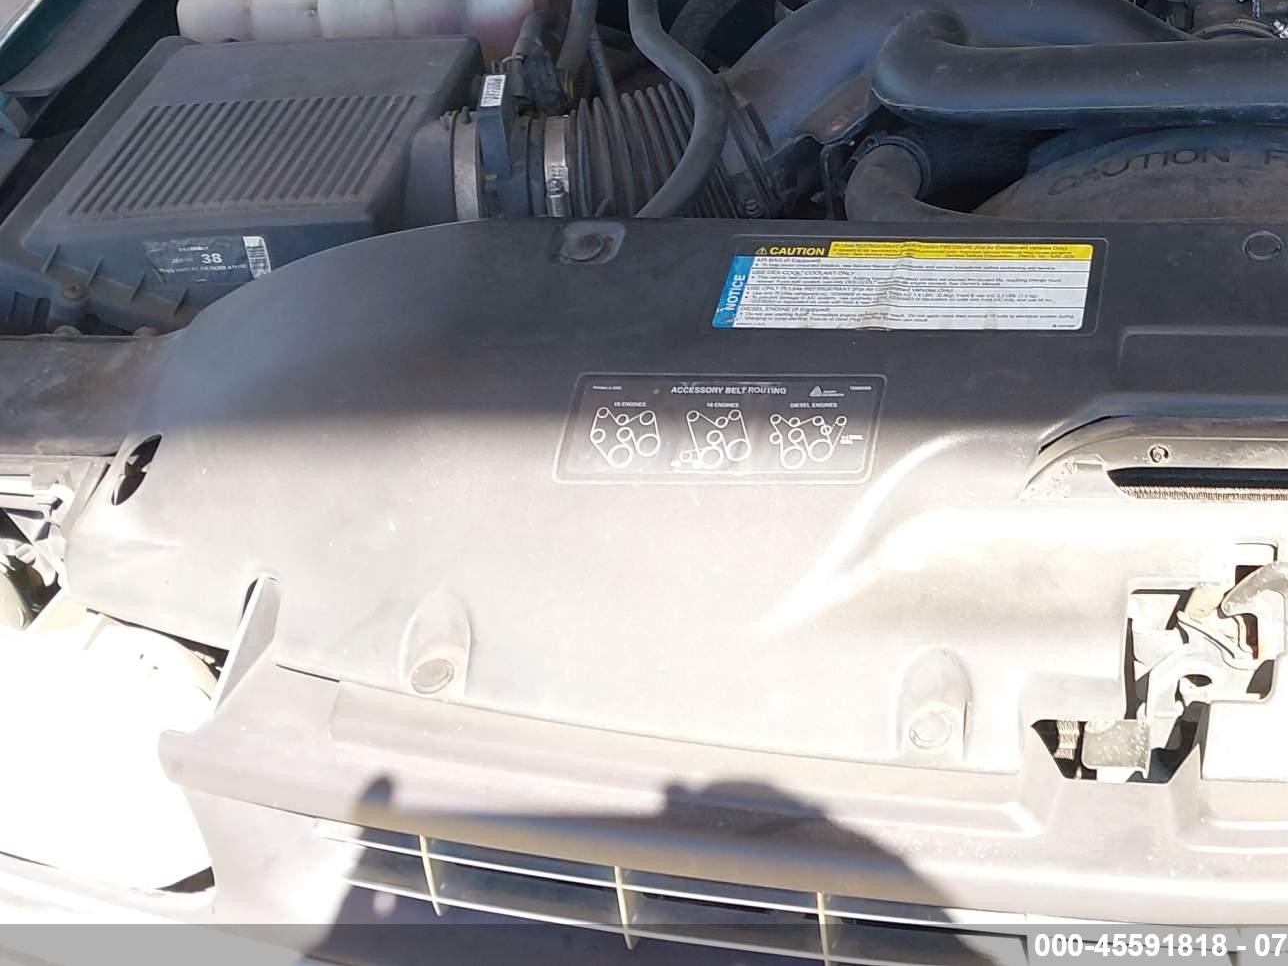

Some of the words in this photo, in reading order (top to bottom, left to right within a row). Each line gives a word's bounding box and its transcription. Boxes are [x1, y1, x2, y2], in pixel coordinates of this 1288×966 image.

[1047, 148, 1231, 196] CAUTION
[769, 246, 825, 256] CAUTION
[200, 252, 223, 264] 38
[725, 273, 746, 311] NOTICE
[671, 386, 724, 394] ACCESSORY
[725, 386, 747, 395] BELT
[747, 386, 787, 395] ROUTING
